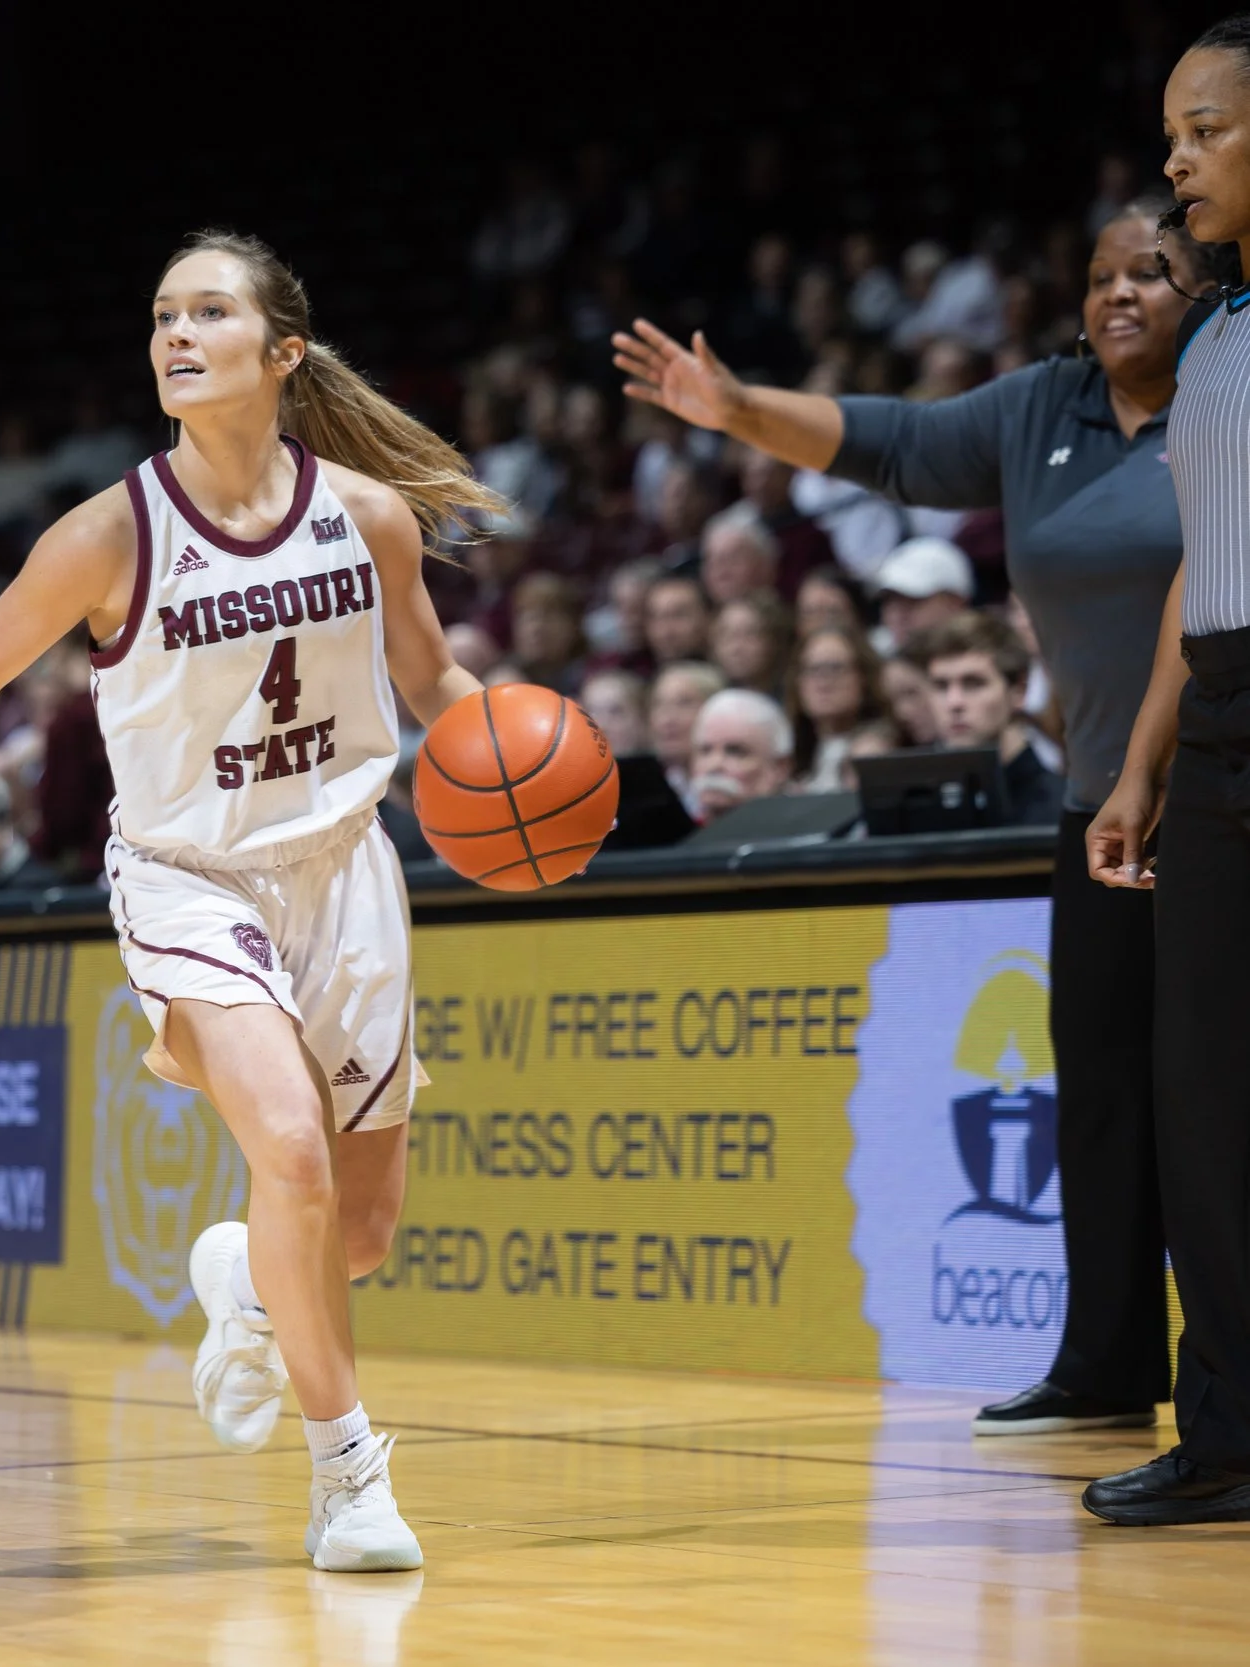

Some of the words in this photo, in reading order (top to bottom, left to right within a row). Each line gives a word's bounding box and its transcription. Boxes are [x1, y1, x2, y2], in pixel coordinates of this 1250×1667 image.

[158, 563, 374, 651] MISSOURI
[173, 560, 210, 576] adidas
[258, 636, 301, 725] 4
[213, 715, 336, 791] STATE
[475, 993, 536, 1073] W/
[545, 991, 659, 1060] FREE
[672, 985, 861, 1058] COFFEE
[331, 1073, 371, 1087] adidas
[586, 1111, 778, 1182] CENTER
[350, 1226, 489, 1293] URED
[500, 1228, 618, 1300] GATE
[635, 1234, 793, 1308] ENTRY
